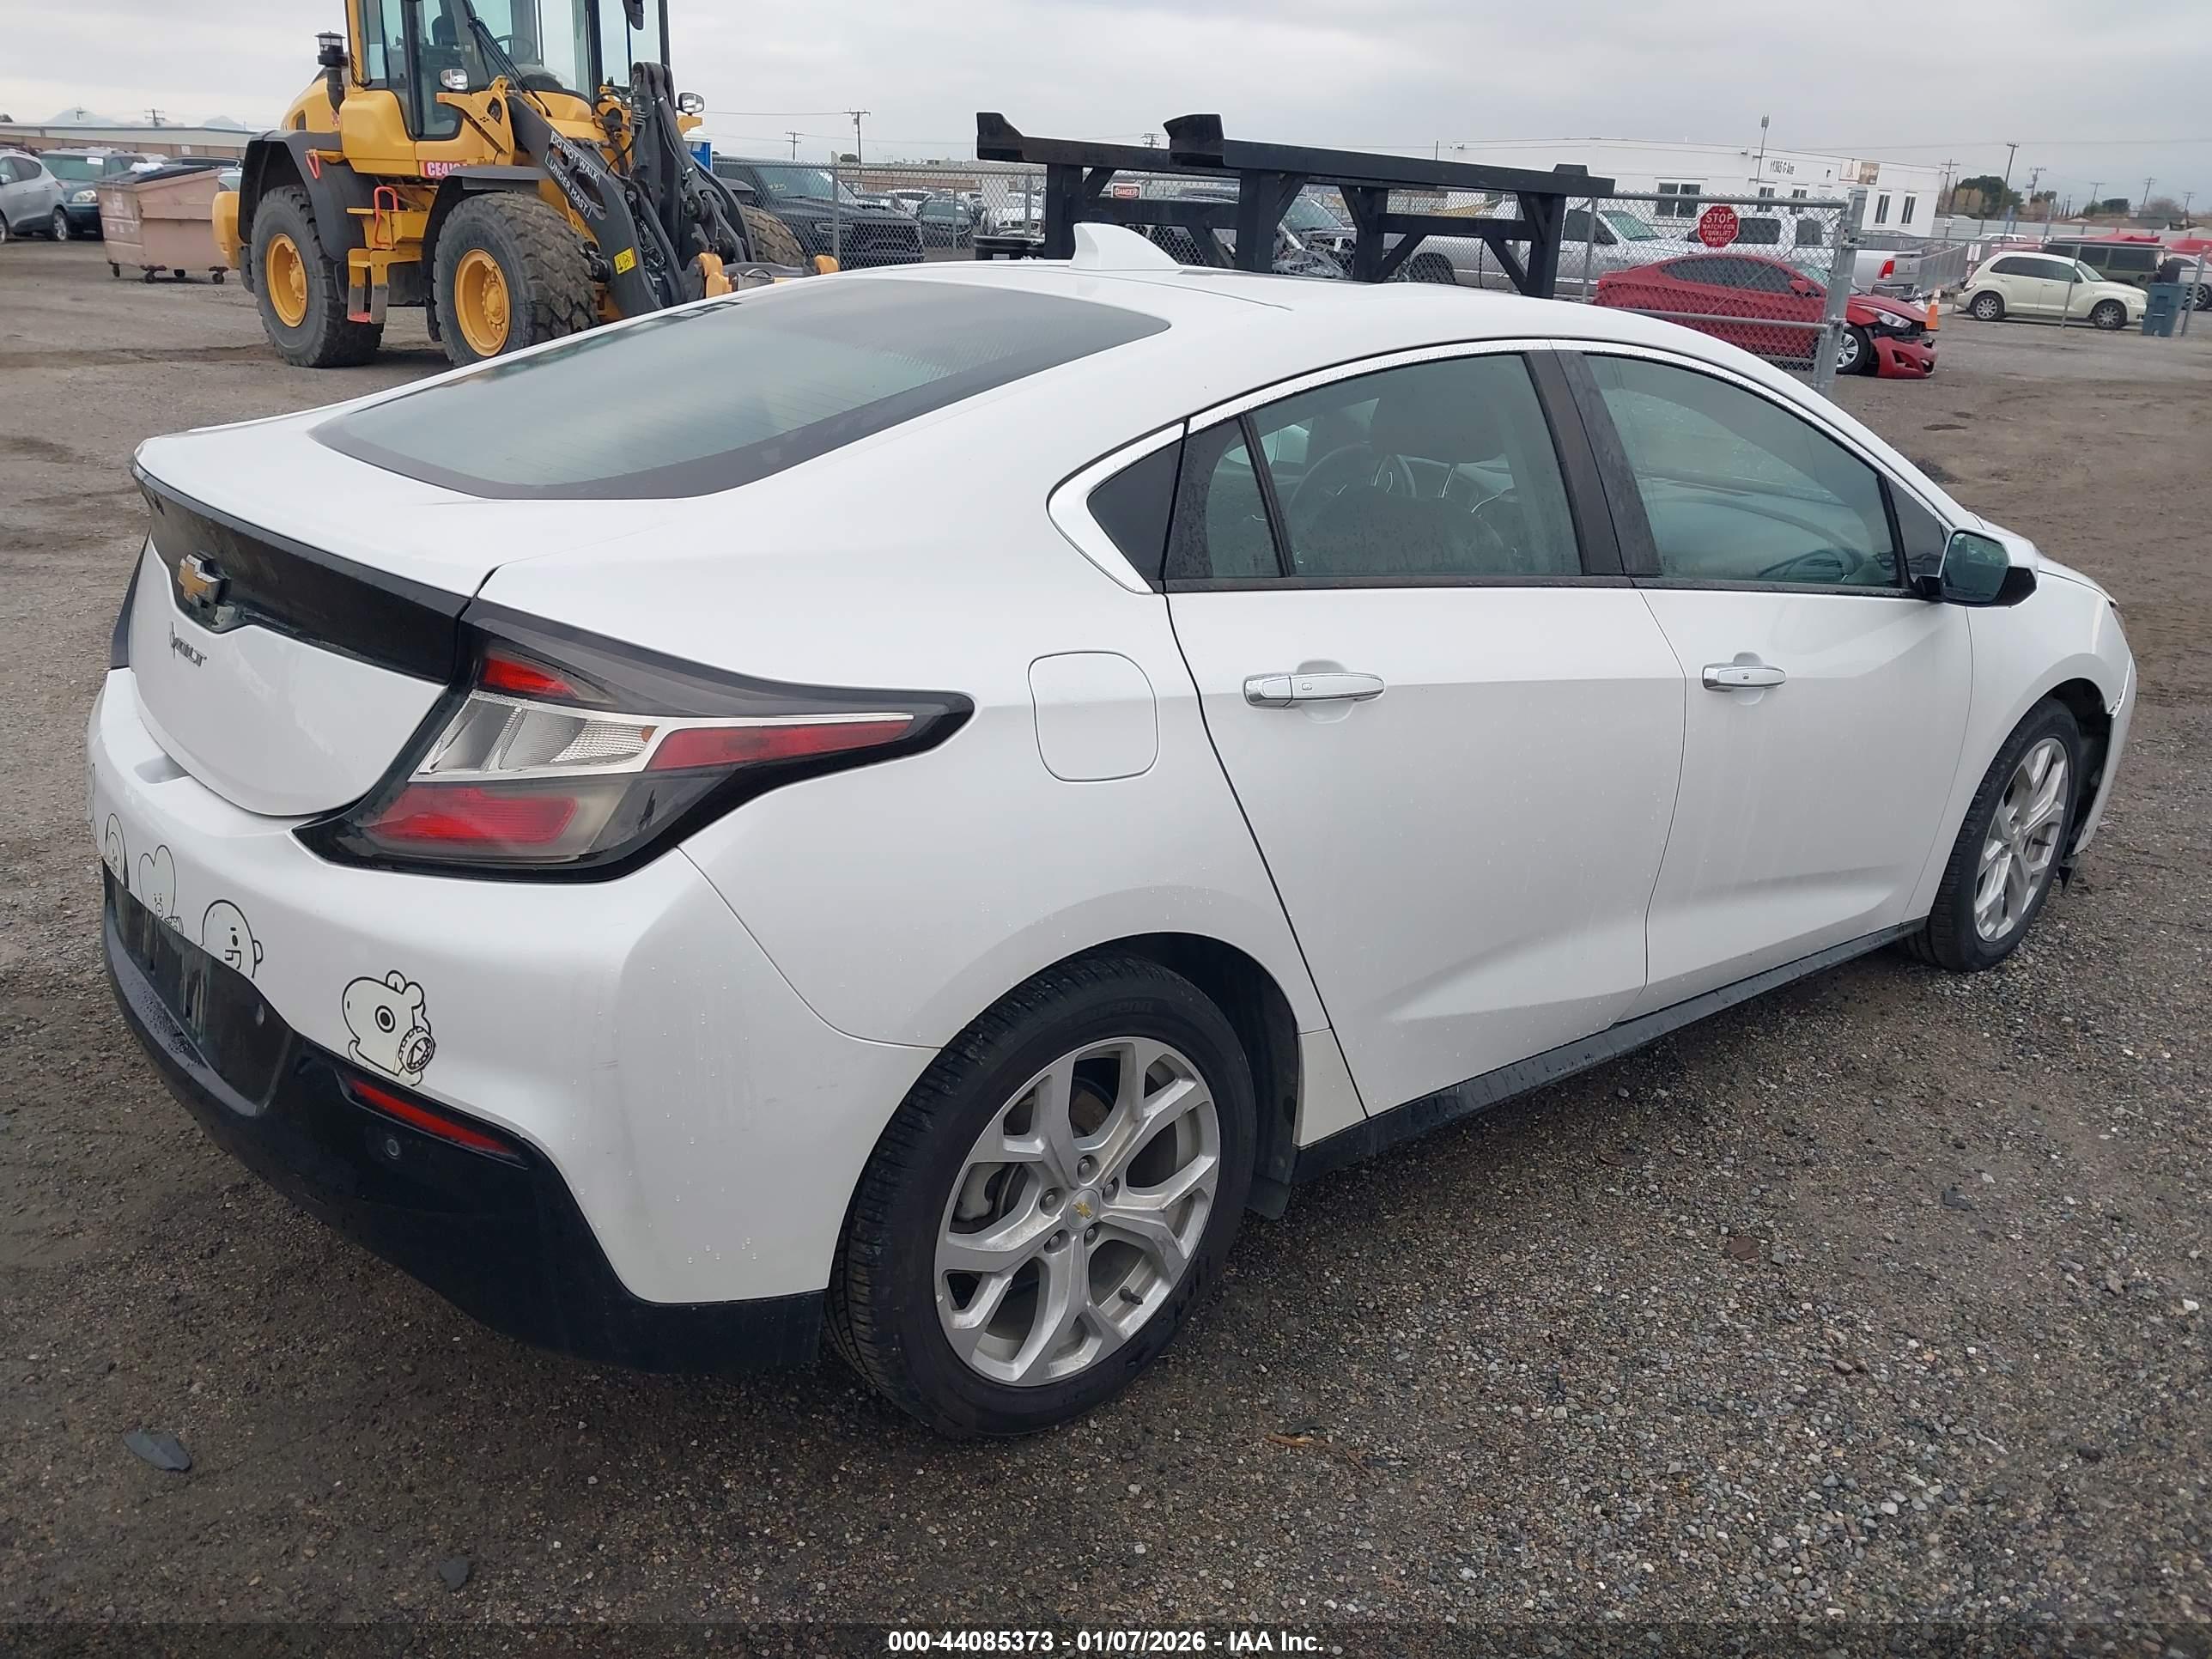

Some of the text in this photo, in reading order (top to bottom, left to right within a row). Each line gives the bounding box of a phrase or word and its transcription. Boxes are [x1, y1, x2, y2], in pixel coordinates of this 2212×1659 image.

[550, 135, 599, 183] DO NOT WALK
[549, 159, 590, 212] UNDER MAST
[1705, 213, 1735, 223] STOP
[169, 621, 207, 667] VOLT
